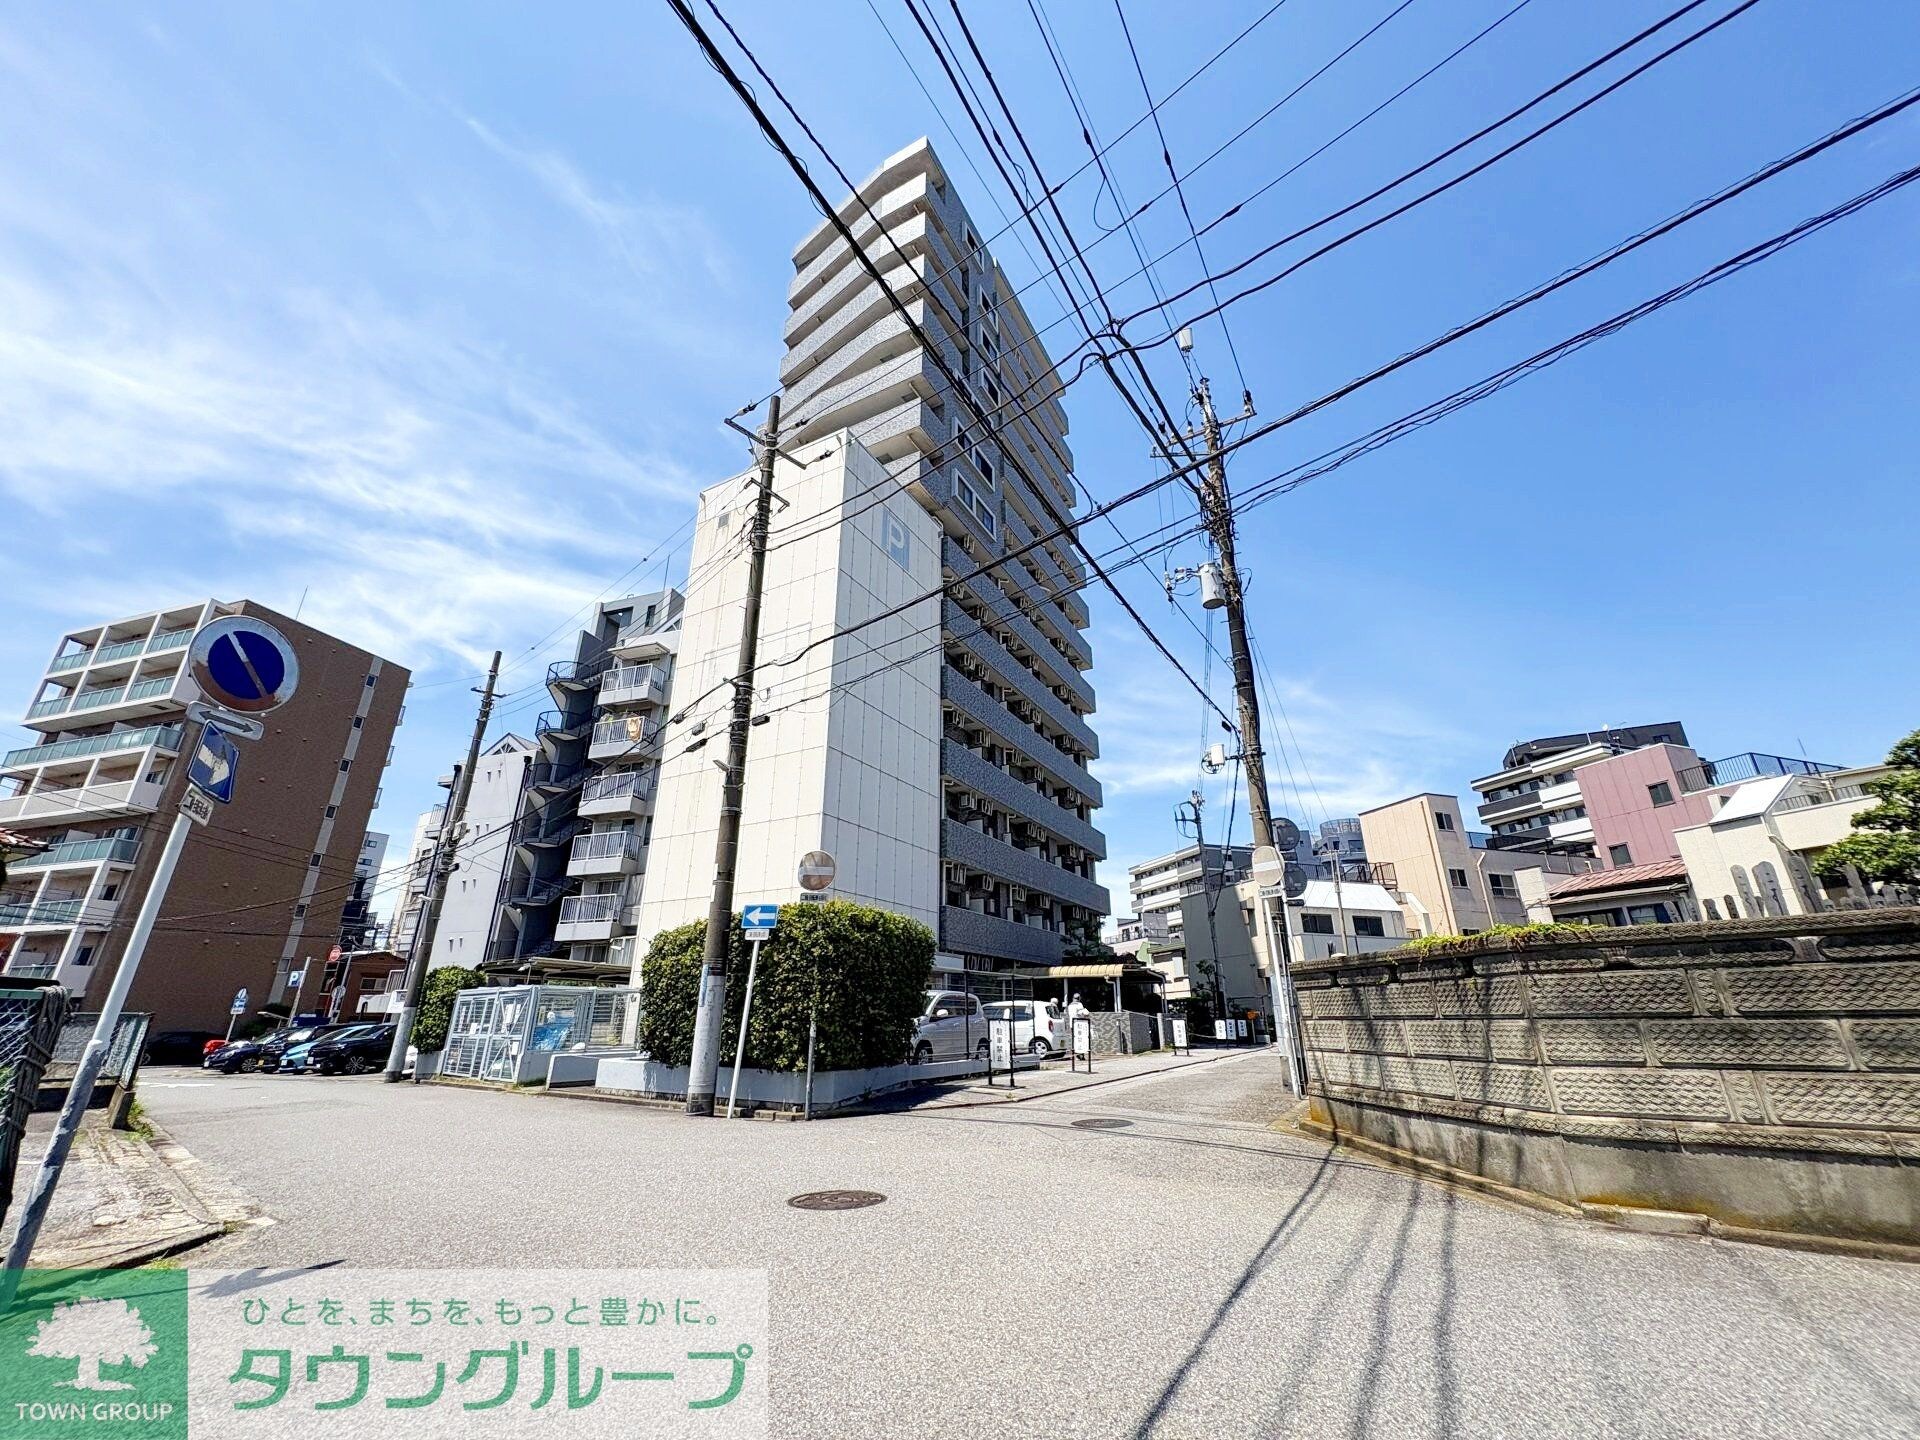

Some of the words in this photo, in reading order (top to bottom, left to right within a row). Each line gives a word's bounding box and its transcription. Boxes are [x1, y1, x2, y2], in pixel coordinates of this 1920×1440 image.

[888, 517, 905, 554] P
[289, 971, 299, 986] P
[996, 1027, 1004, 1062] 駐車禁止
